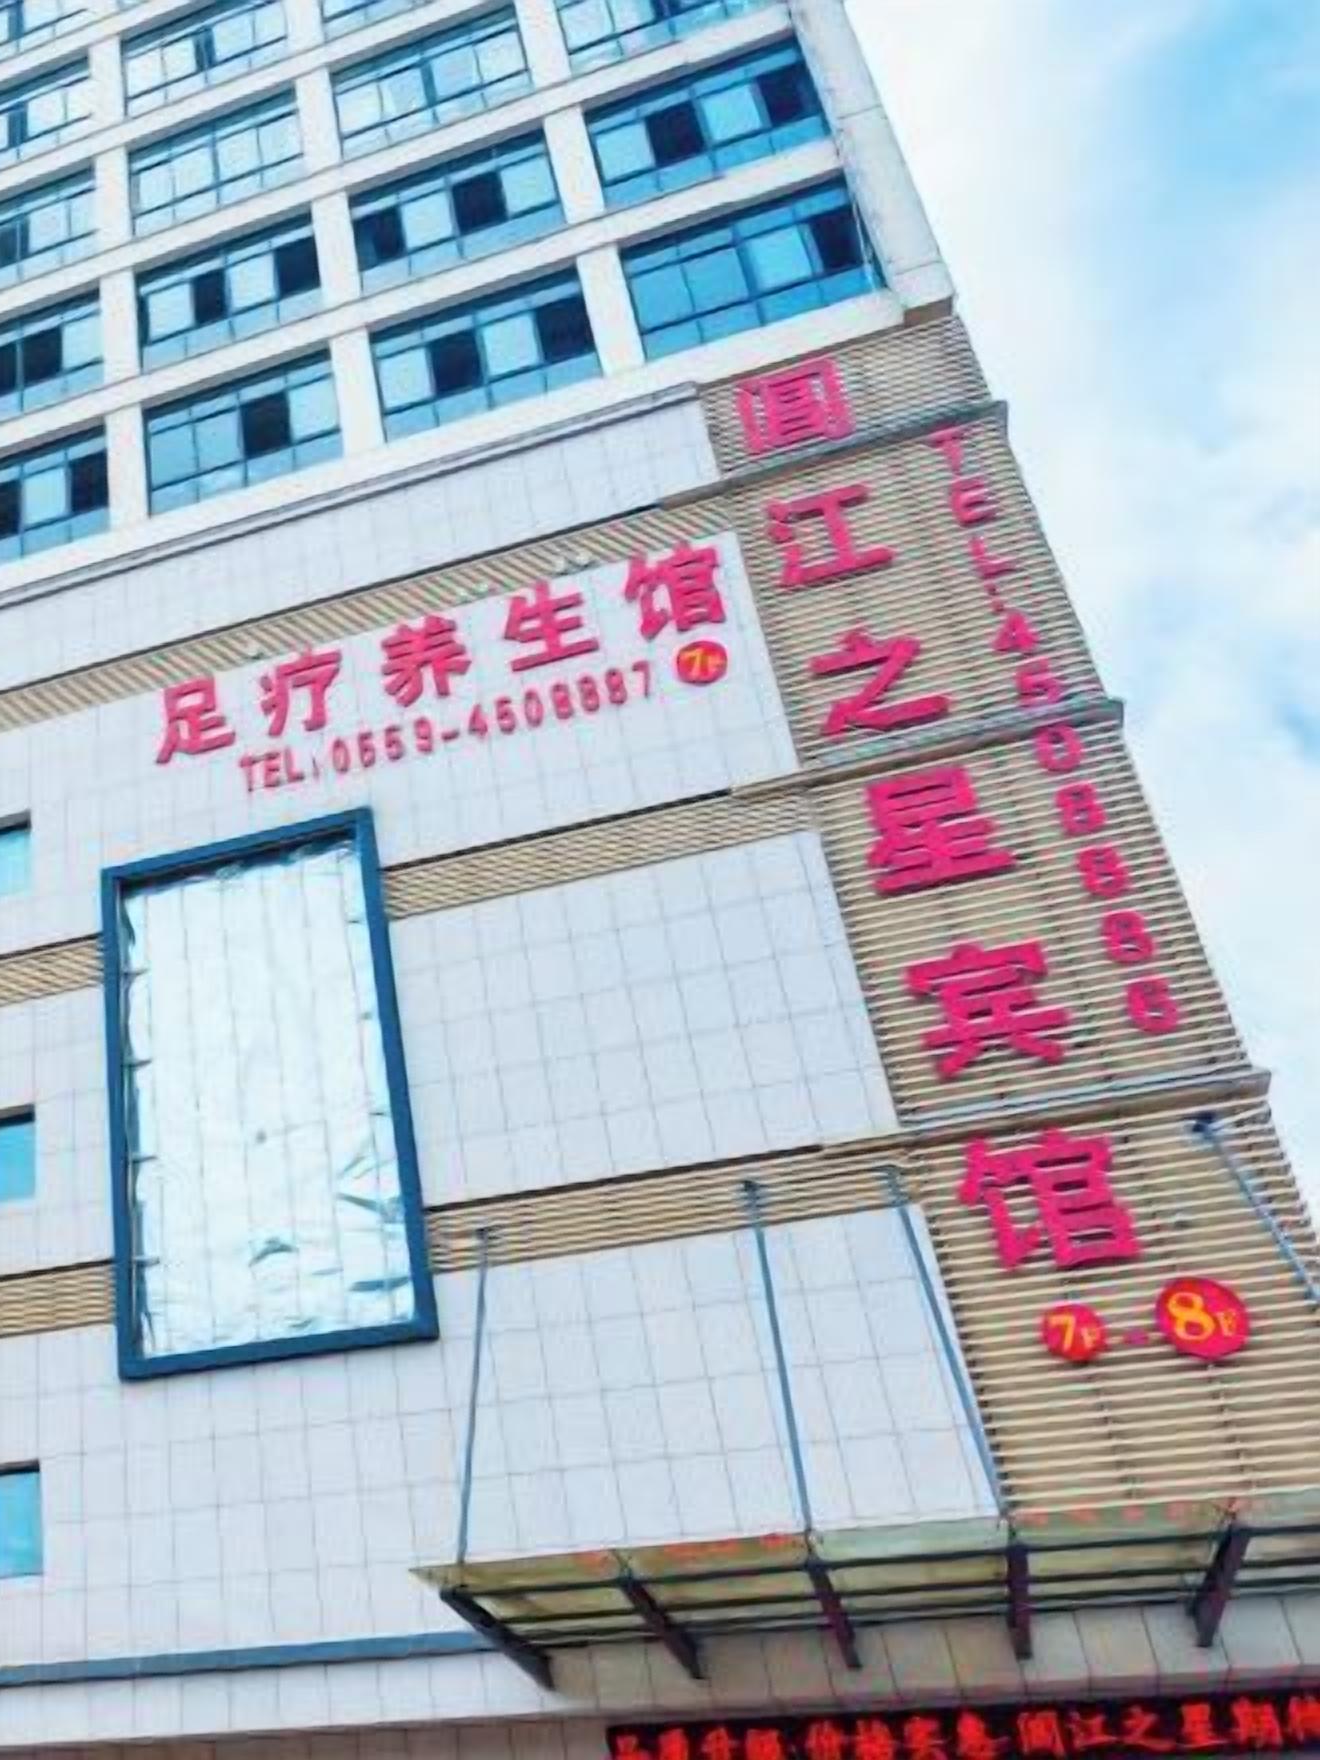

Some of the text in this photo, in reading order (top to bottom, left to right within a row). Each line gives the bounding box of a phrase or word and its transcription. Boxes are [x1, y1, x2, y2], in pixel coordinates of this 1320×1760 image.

[156, 541, 727, 764] 足疗养生馆
